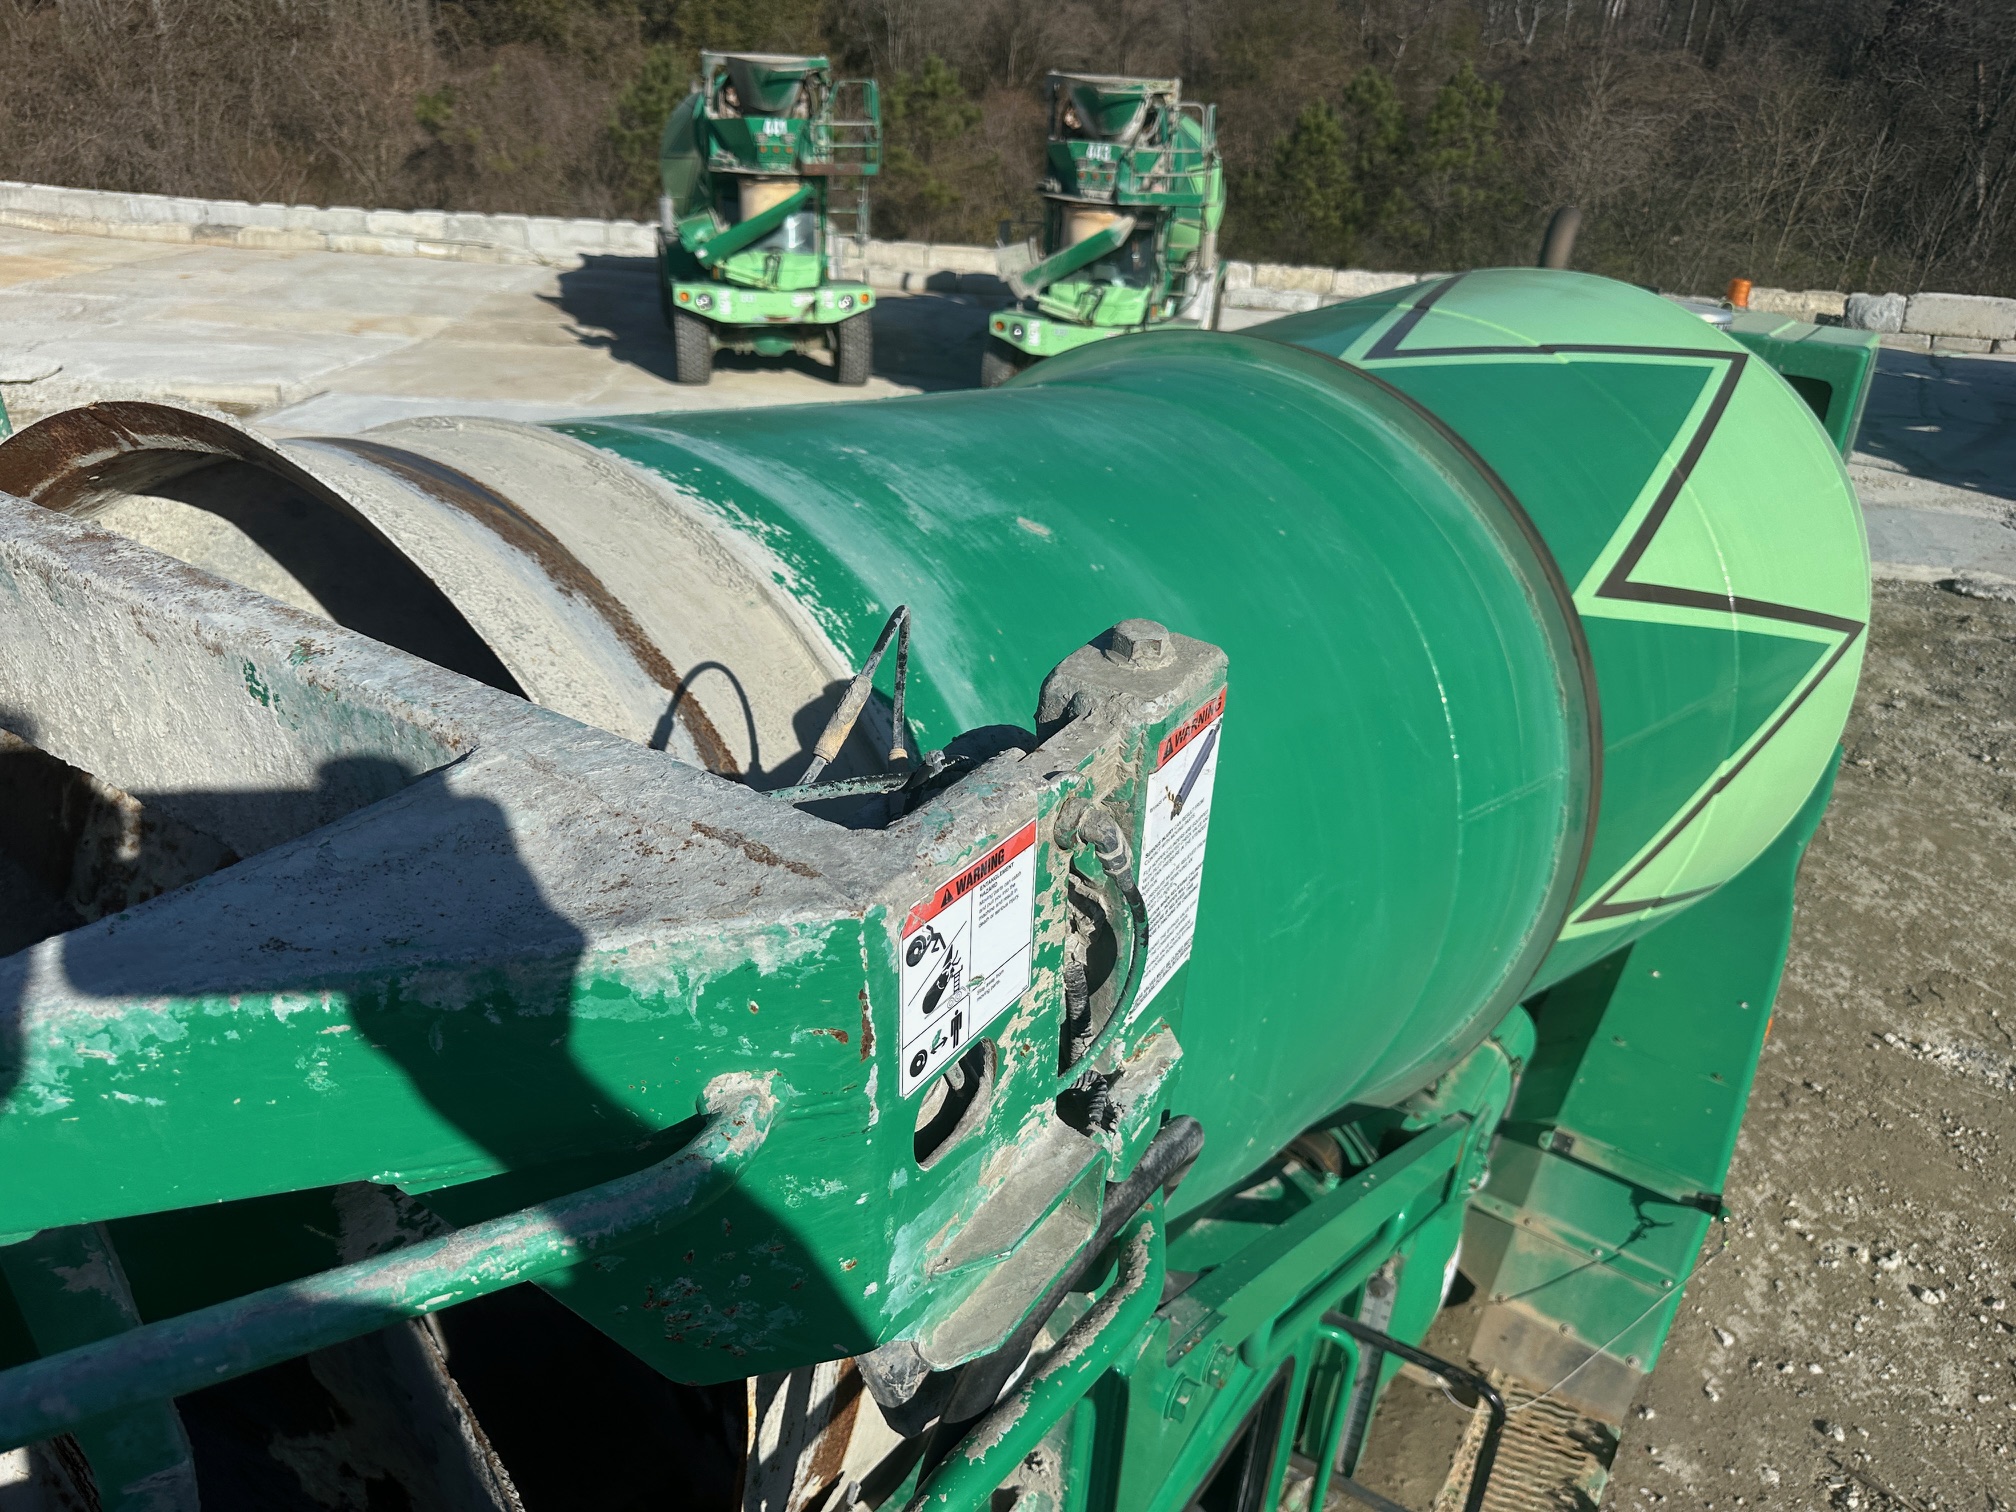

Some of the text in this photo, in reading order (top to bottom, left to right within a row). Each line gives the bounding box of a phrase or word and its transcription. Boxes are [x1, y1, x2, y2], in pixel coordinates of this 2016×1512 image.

[1175, 696, 1222, 747] WARNING
[956, 849, 1004, 895] WARNING
[980, 882, 998, 898] HAZARD
